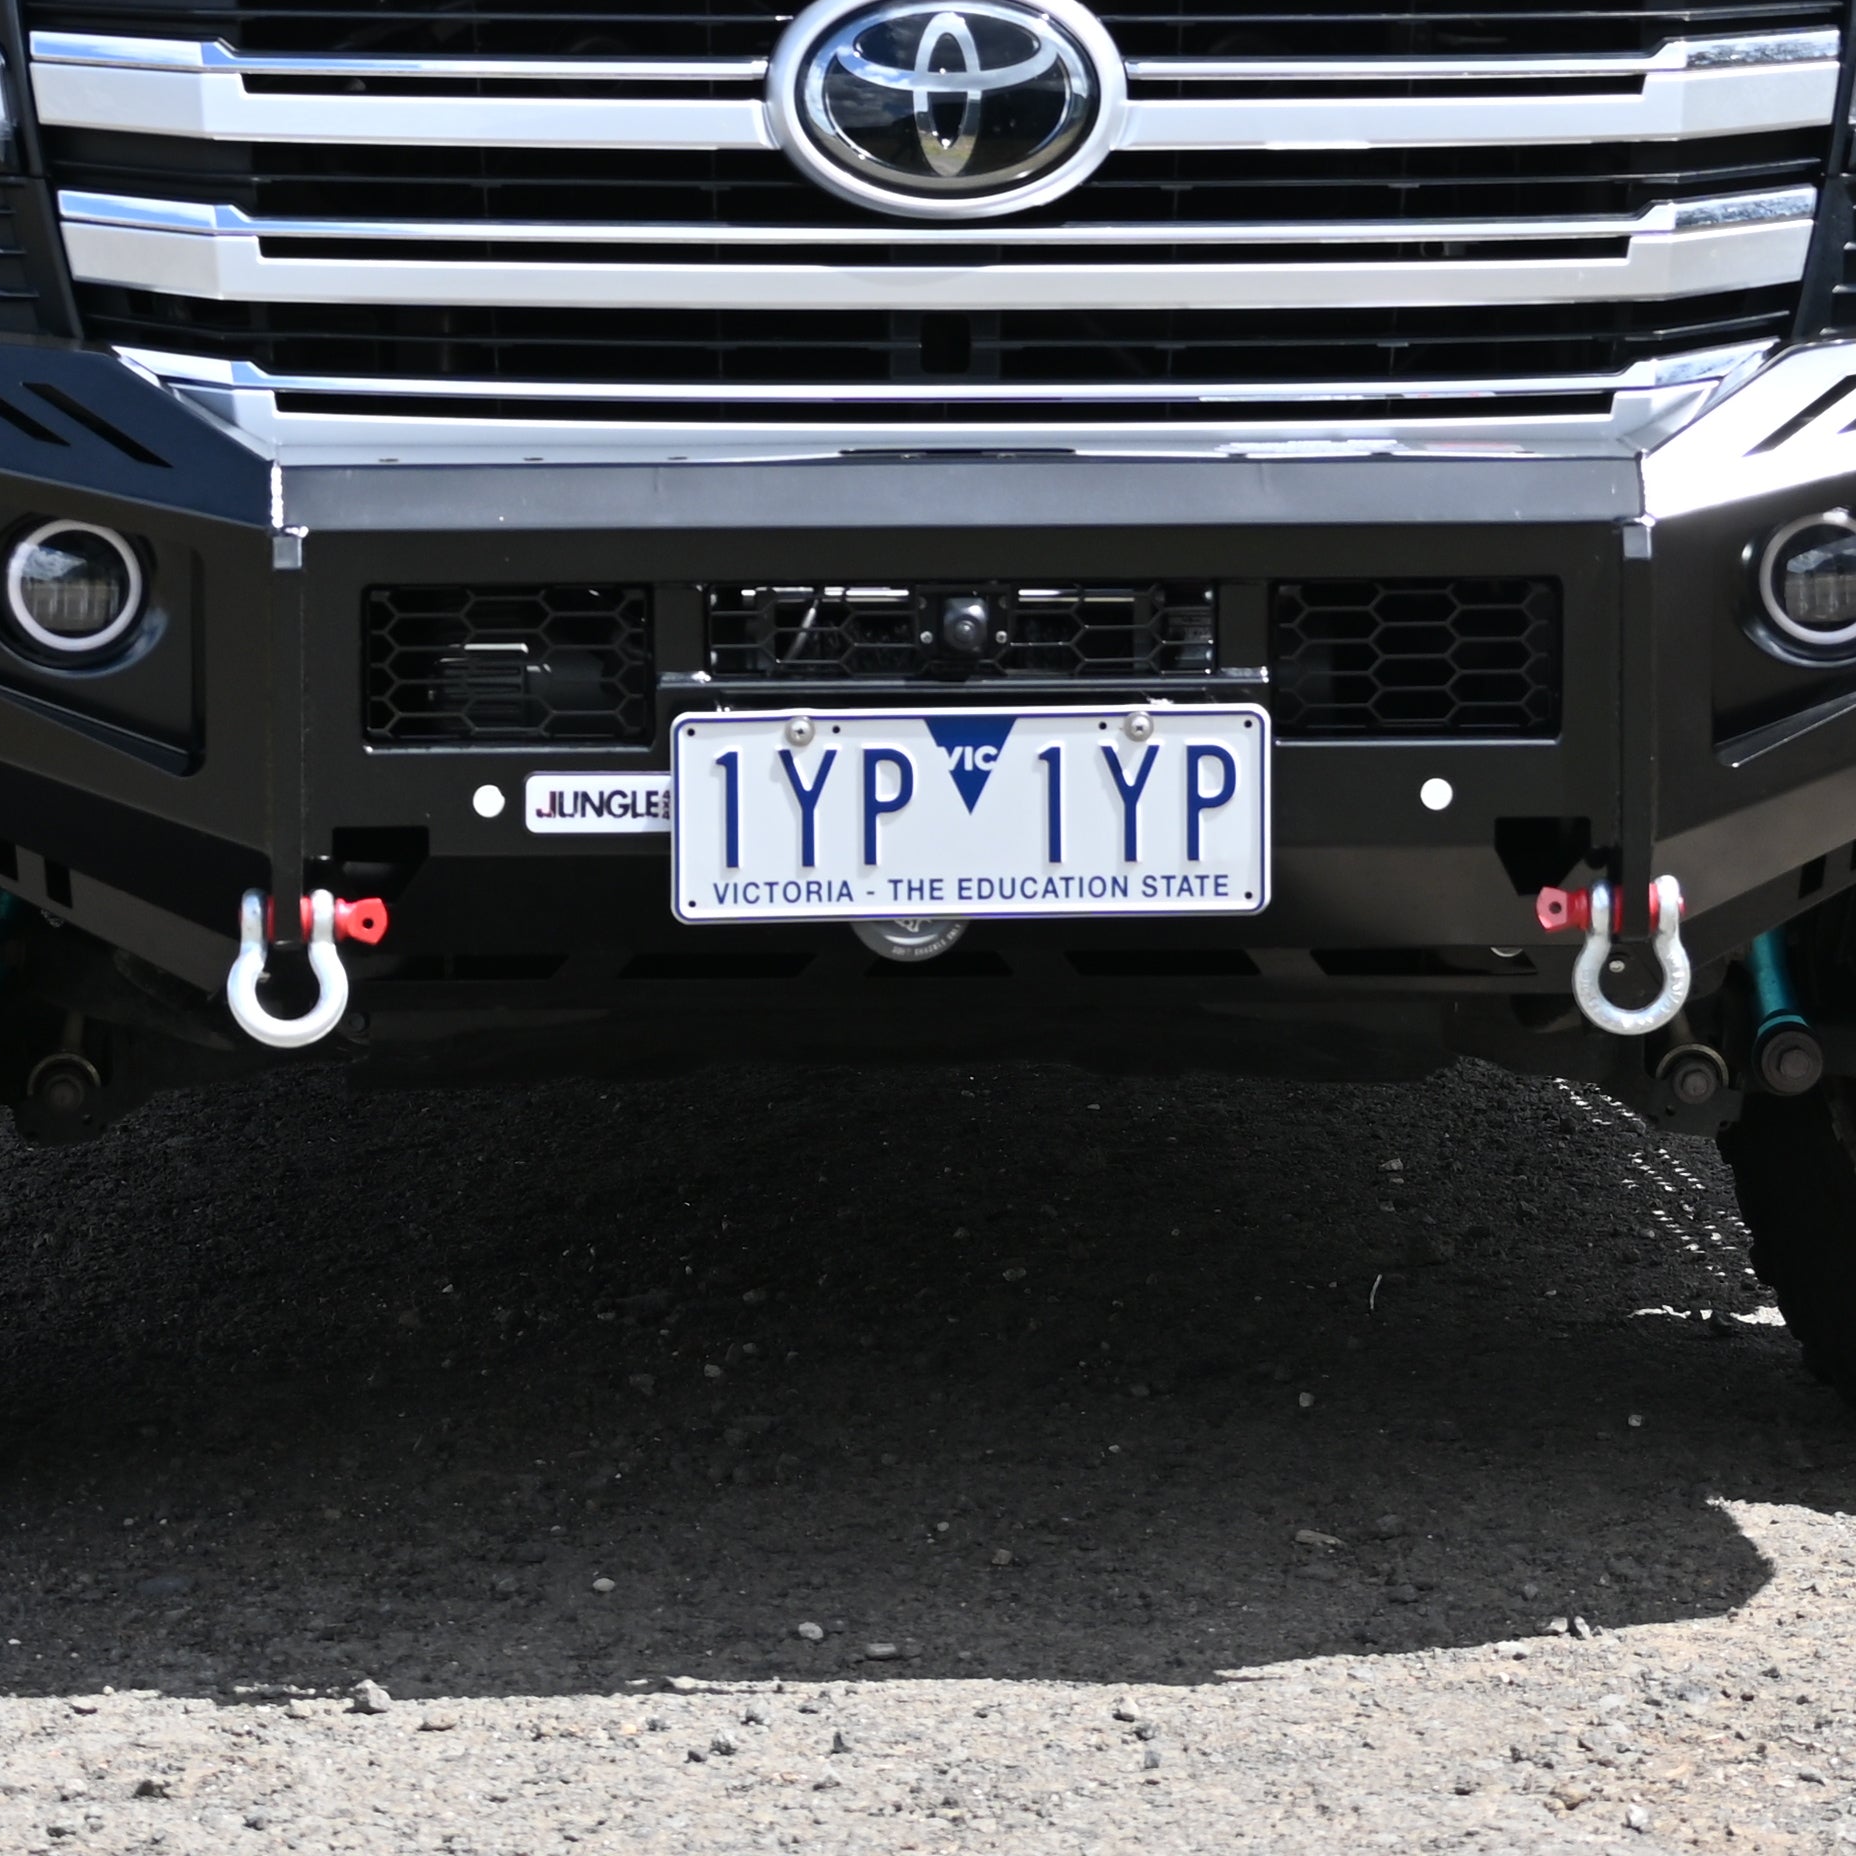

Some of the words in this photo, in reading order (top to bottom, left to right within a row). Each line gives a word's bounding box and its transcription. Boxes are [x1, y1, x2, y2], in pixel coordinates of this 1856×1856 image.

[937, 745, 999, 772] VIC
[536, 789, 659, 819] JUNGLE
[715, 746, 915, 868] 1YP
[1038, 744, 1237, 863] 1YP
[713, 880, 854, 905] VICTORIA
[888, 878, 945, 902] THE
[957, 876, 1130, 901] EDUCATION
[1142, 874, 1230, 898] STATE
